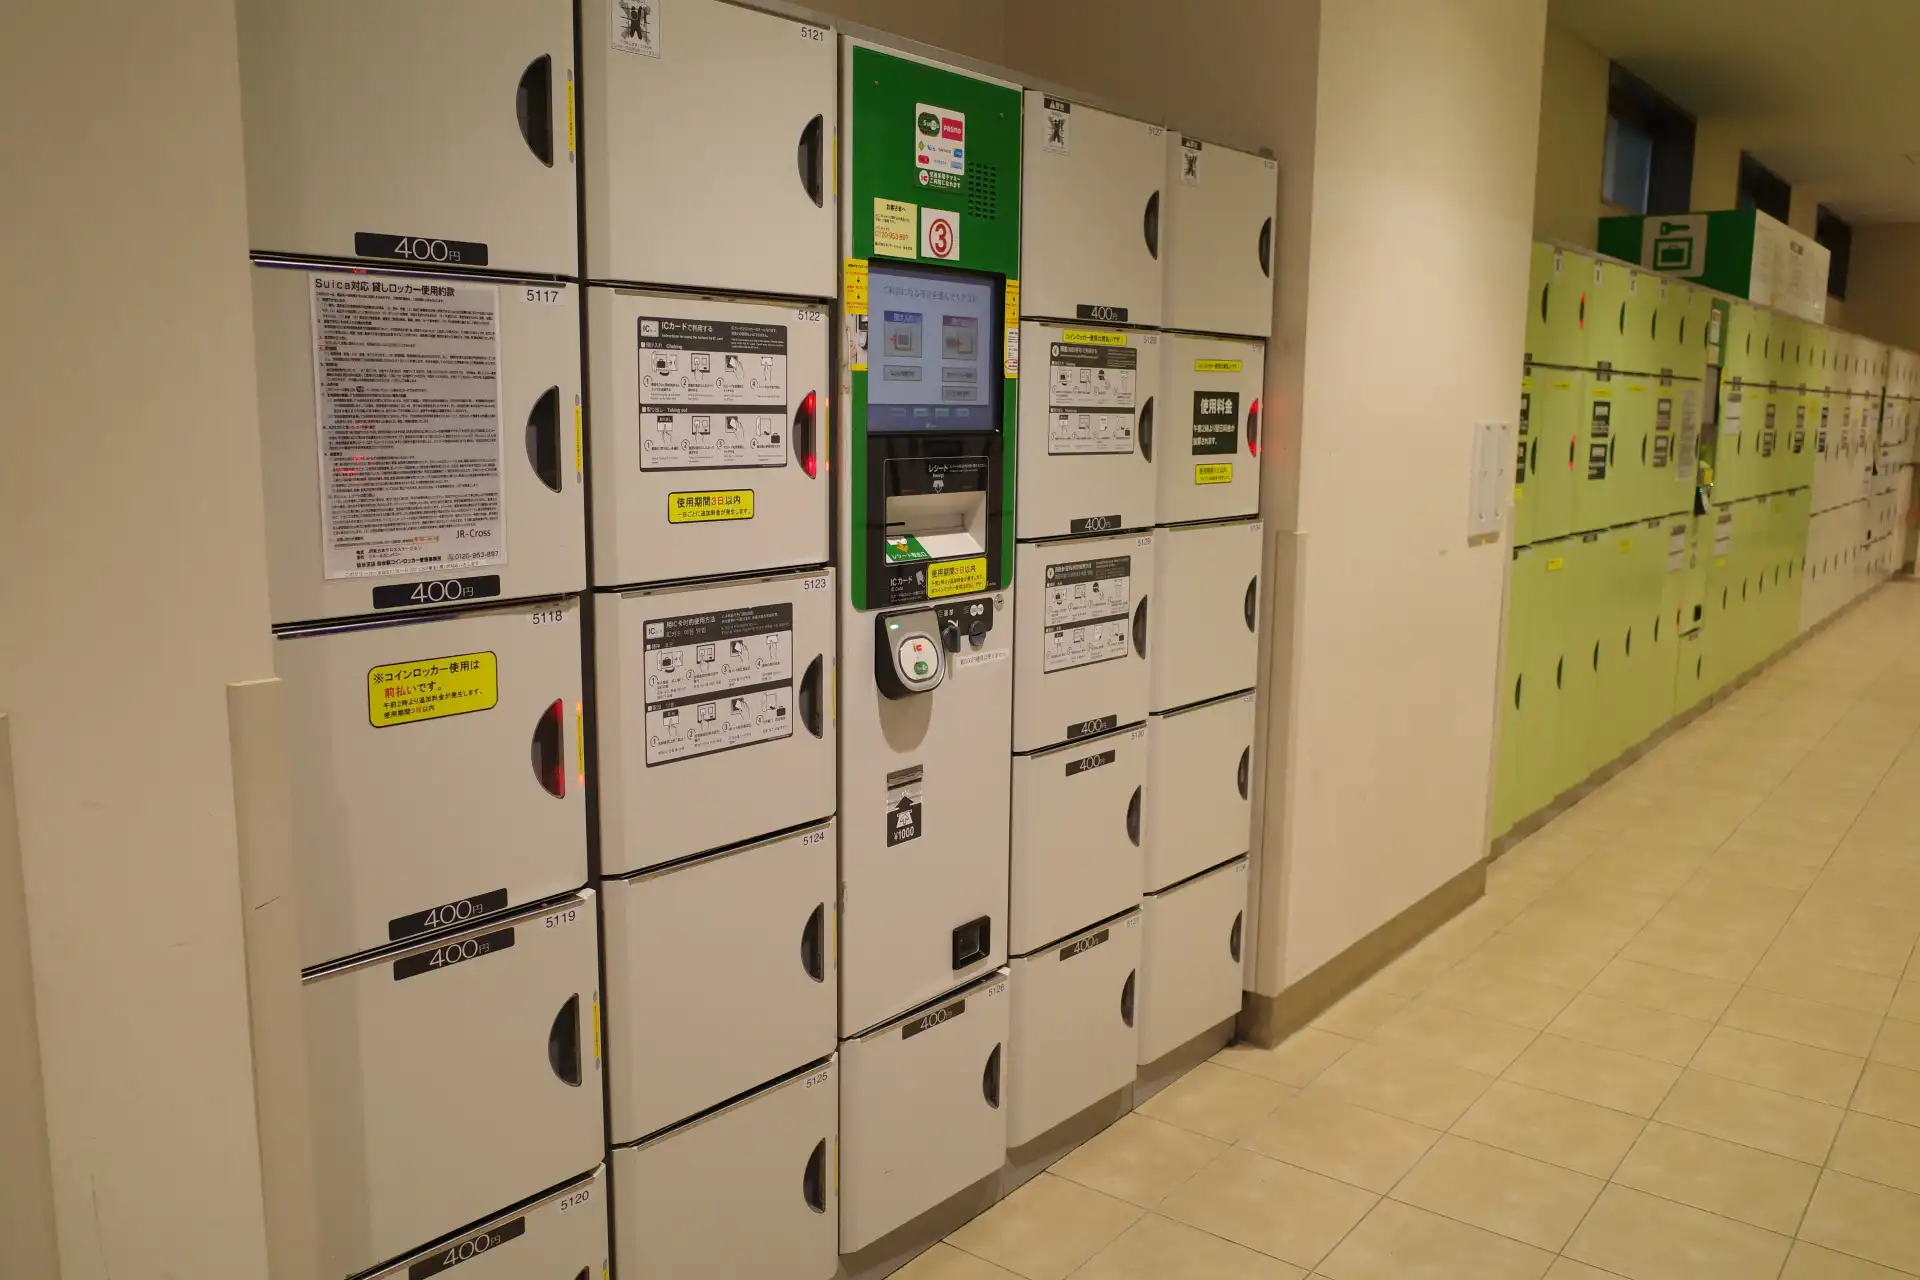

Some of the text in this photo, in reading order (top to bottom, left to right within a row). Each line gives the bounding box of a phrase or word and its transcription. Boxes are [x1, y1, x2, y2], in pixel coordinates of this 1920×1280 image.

[801, 26, 824, 42] 5121
[394, 237, 460, 262] 400円
[526, 289, 559, 303] 5117
[798, 309, 821, 322] 5122
[1200, 397, 1233, 415] 使用料金
[928, 464, 949, 473] レシート
[676, 495, 741, 508] 使用期間3日以内
[456, 529, 491, 539] JR-Cross
[803, 578, 827, 591] 5123
[889, 577, 913, 588] ICカード
[410, 579, 474, 604] 400円
[532, 609, 563, 626] 5118
[373, 659, 481, 684] ※コインロッカー使用は
[384, 680, 442, 699] 前払いです。
[383, 688, 483, 709] 午前2時より追加料金が発生します。
[383, 705, 435, 719] 使用期間3日以内
[803, 831, 825, 846] 5124
[893, 825, 915, 842] ¥1000
[423, 900, 484, 928] 400円
[545, 910, 576, 929] 5119
[429, 939, 490, 968] 400円
[988, 983, 1005, 997] 5126
[806, 1072, 828, 1089] 5125
[560, 1190, 589, 1211] 5120
[442, 1233, 501, 1267] 400円
